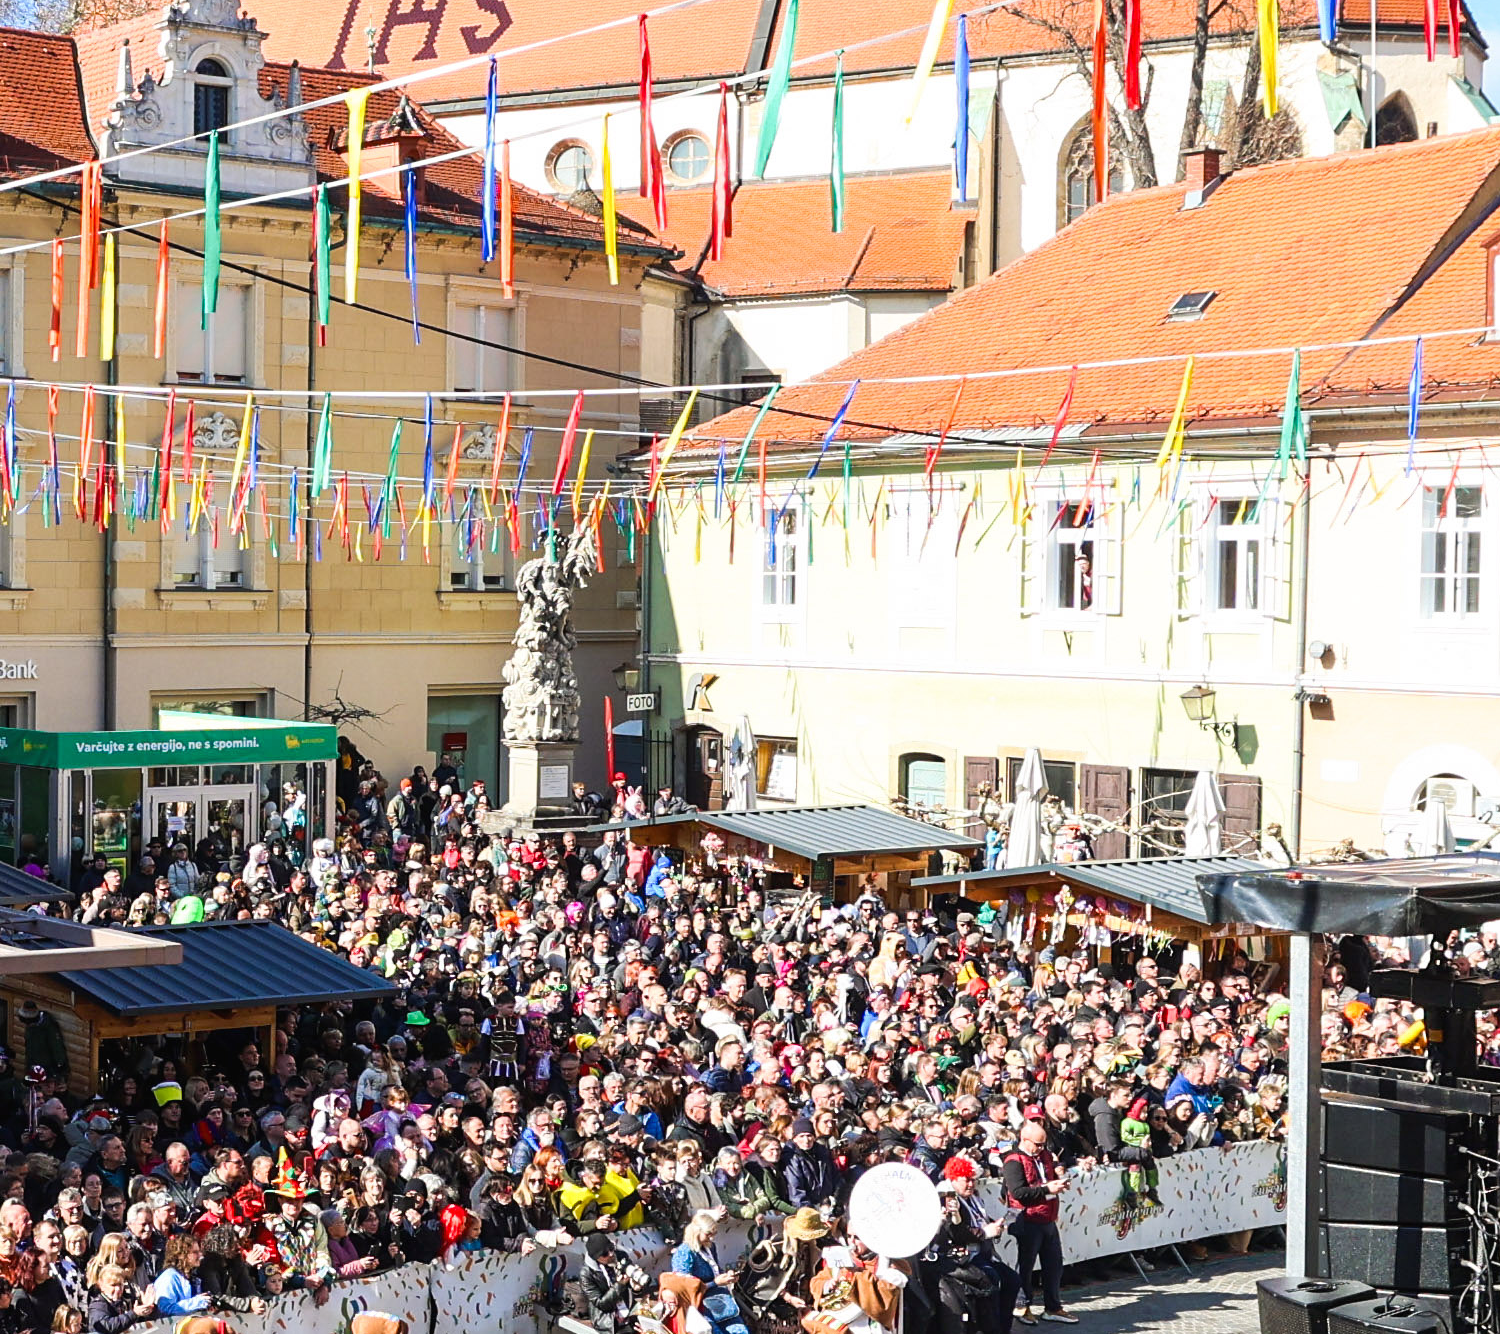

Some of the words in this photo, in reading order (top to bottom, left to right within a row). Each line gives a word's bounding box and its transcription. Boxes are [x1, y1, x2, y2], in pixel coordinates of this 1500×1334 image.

[629, 696, 653, 709] FOTO
[75, 741, 125, 755] Varčujte
[127, 743, 134, 751] z
[136, 739, 186, 753] energijo,
[188, 741, 202, 750] ne
[204, 740, 211, 749] s
[213, 737, 259, 751] spomini.
